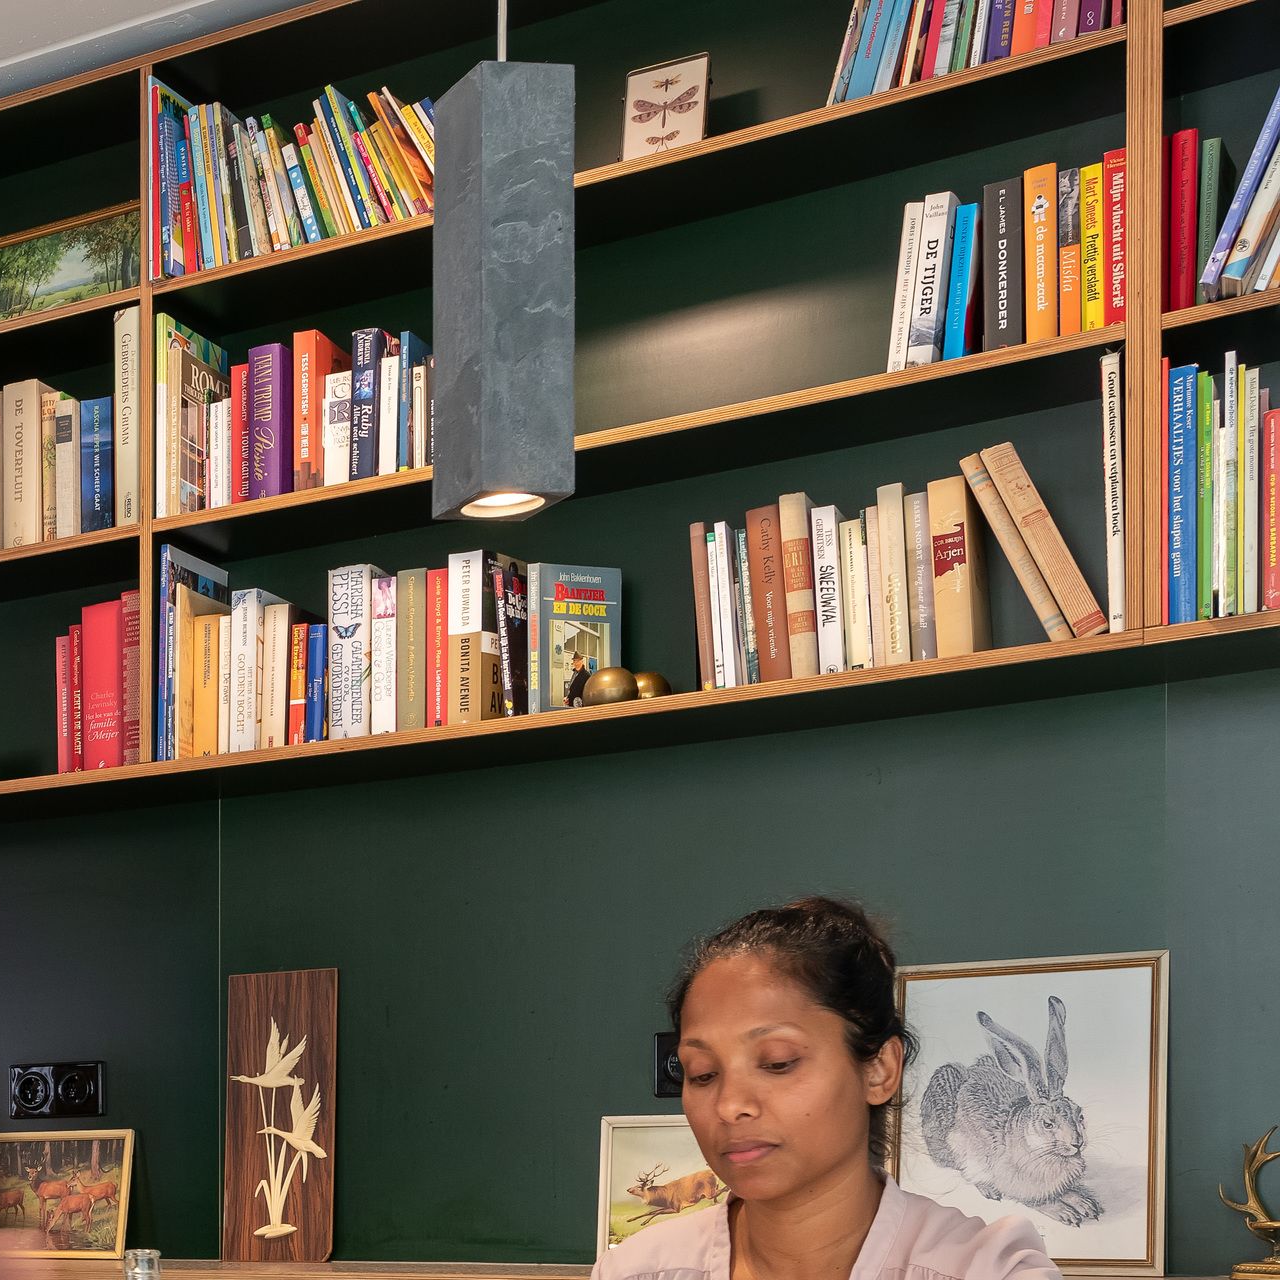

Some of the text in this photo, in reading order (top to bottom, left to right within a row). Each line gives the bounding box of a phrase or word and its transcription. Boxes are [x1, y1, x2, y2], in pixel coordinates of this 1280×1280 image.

[908, 218, 916, 236] JORIS
[1036, 226, 1047, 241] de
[1084, 177, 1100, 302] Mart Smeets Prettig verslaafd
[1110, 172, 1124, 308] Mijn vlucht uit Siberië
[904, 238, 915, 275] LUYENDIJK
[1062, 251, 1078, 292] Misha
[920, 239, 939, 317] DE TIJGER
[998, 239, 1007, 330] DONKERDER
[899, 311, 907, 325] NET
[900, 295, 908, 309] ZIJN
[363, 334, 372, 364] VIRGINIA
[896, 327, 905, 354] MENSEN
[121, 333, 133, 445] GEBROEDERS GRIMM
[190, 363, 230, 398] ROME
[254, 353, 275, 481] IVANA TRUMP Passie
[359, 404, 372, 437] Ruby
[14, 398, 24, 503] DE TOVERFLUIT
[351, 443, 359, 475] schittert
[1107, 372, 1120, 536] Groot cactussen en vetplanten boek
[1171, 377, 1183, 577] VERHAALTJES voor het slapen gaan
[816, 519, 825, 559] GERRITSEN
[824, 529, 833, 547] TESS
[915, 531, 923, 560] NOORT
[935, 546, 964, 560] Arjen
[759, 518, 778, 658] Cathy Kelly Voor mijn vriendin
[915, 565, 925, 586] Terug
[332, 572, 349, 626] PESSL
[351, 570, 362, 620] MARISHA
[569, 603, 582, 615] DE
[583, 604, 606, 616] COCK
[819, 565, 836, 627] SNEEUWVAL
[919, 604, 926, 612] de
[373, 621, 384, 656] Gossip
[460, 560, 470, 713] PETER BUWALDA BONITA AVENUE
[384, 620, 393, 697] Lauren Weisberger
[236, 654, 246, 734] GOUDEN BOCHT
[332, 643, 343, 727] GEVORDERDEN
[374, 672, 384, 701] Gucci
[74, 711, 80, 719] IN
[74, 721, 80, 730] DE
[247, 711, 252, 719] DE
